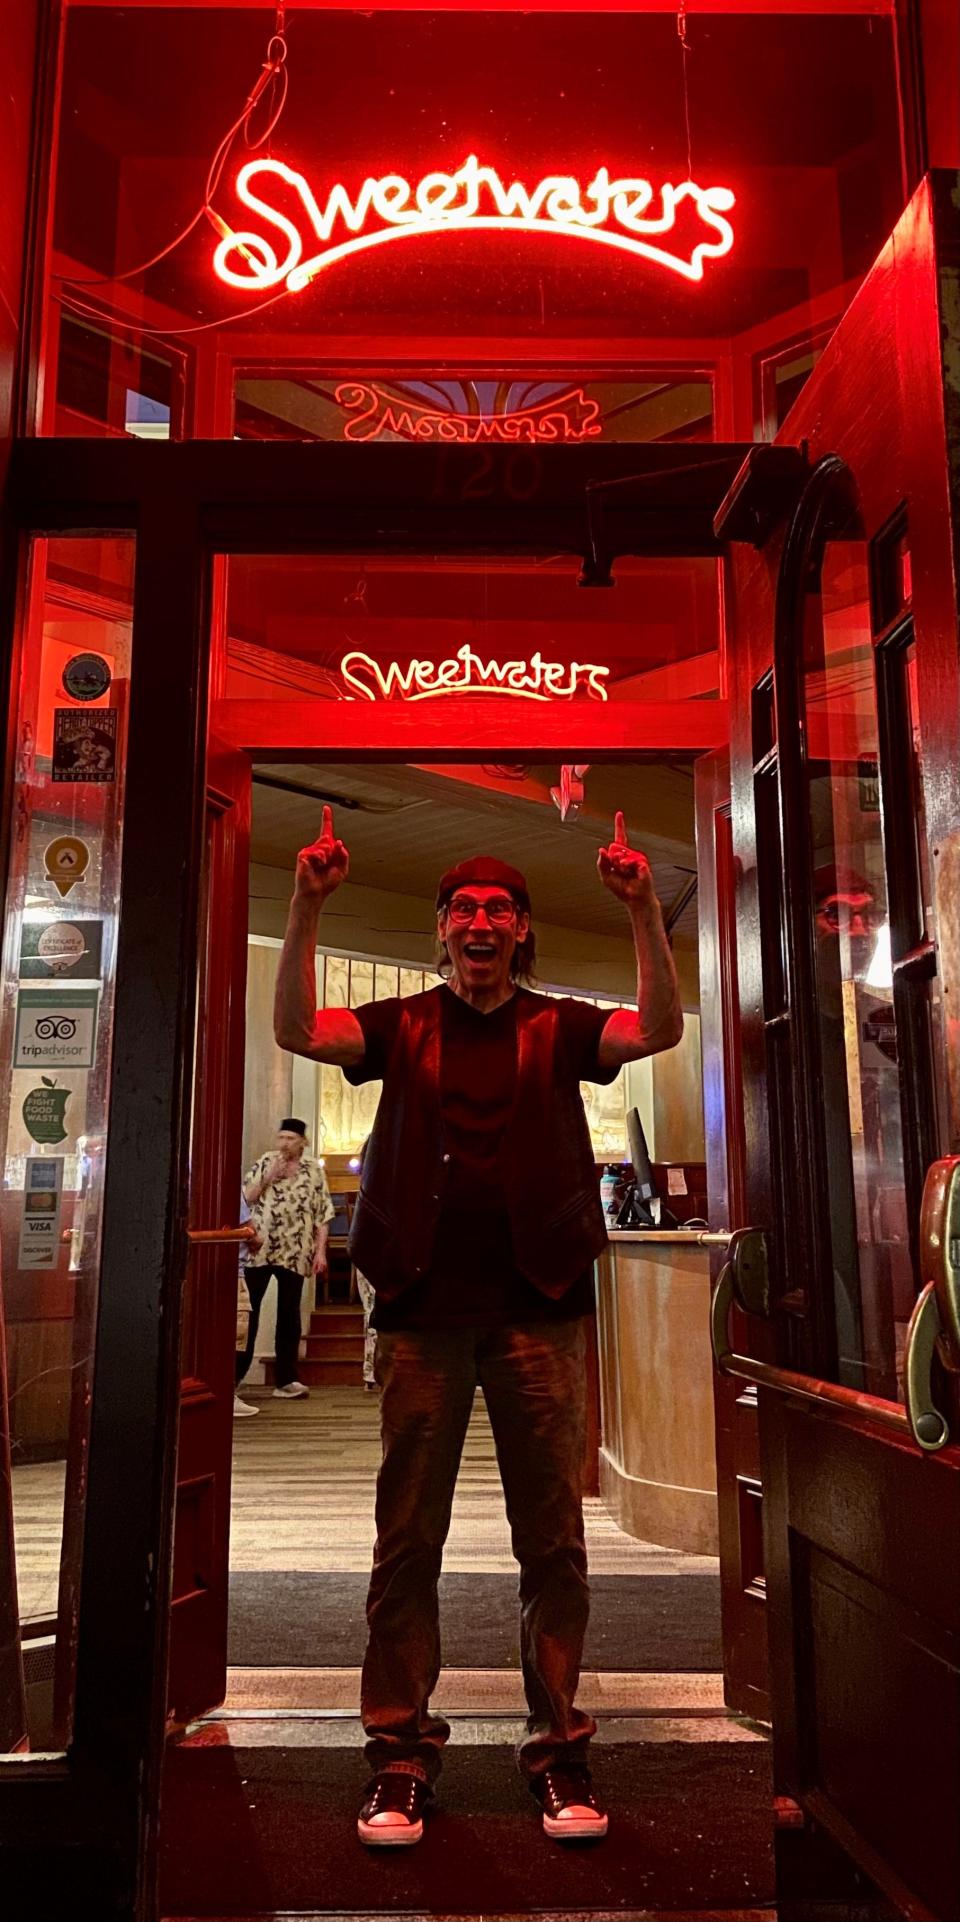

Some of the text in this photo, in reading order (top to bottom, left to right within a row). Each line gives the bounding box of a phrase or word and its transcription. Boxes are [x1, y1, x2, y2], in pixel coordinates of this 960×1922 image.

[213, 154, 735, 290] Sweetwaters
[340, 643, 610, 702] Sweetwaters
[54, 773, 112, 781] RETAILER
[22, 1043, 84, 1058] tripadvisor
[33, 1090, 48, 1098] WE
[27, 1098, 56, 1106] FIGHT
[25, 1105, 53, 1114] FOOD
[27, 1114, 60, 1122] WASTE
[29, 1222, 52, 1231] VISA
